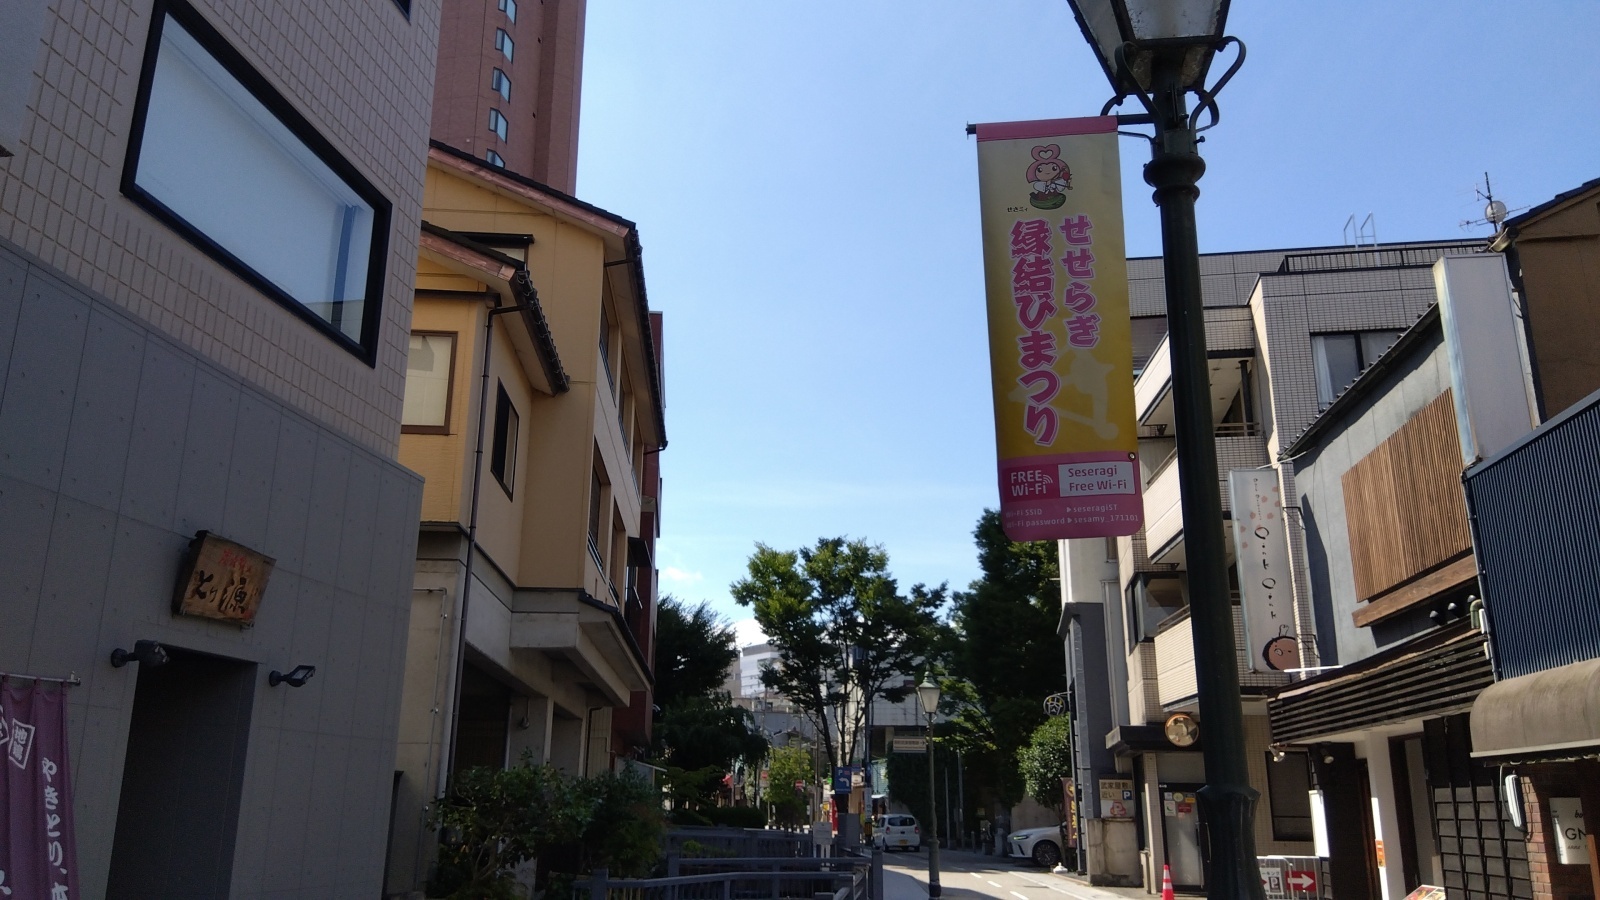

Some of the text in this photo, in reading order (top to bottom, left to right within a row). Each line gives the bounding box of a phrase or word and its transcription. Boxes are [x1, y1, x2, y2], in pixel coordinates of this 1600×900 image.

[1059, 215, 1100, 348] せせらぎ
[1010, 218, 1059, 447] 縁結びまつり
[1010, 470, 1042, 484] FREE
[1068, 465, 1117, 478] Seseragi
[1011, 482, 1047, 497] Wi-Fi
[1069, 480, 1127, 492] Free Wi-Fi
[1025, 508, 1043, 516] SSID
[1073, 504, 1118, 514] seseragiST
[1026, 517, 1065, 527] password
[1262, 577, 1277, 620] Oink
[1123, 791, 1131, 799] P
